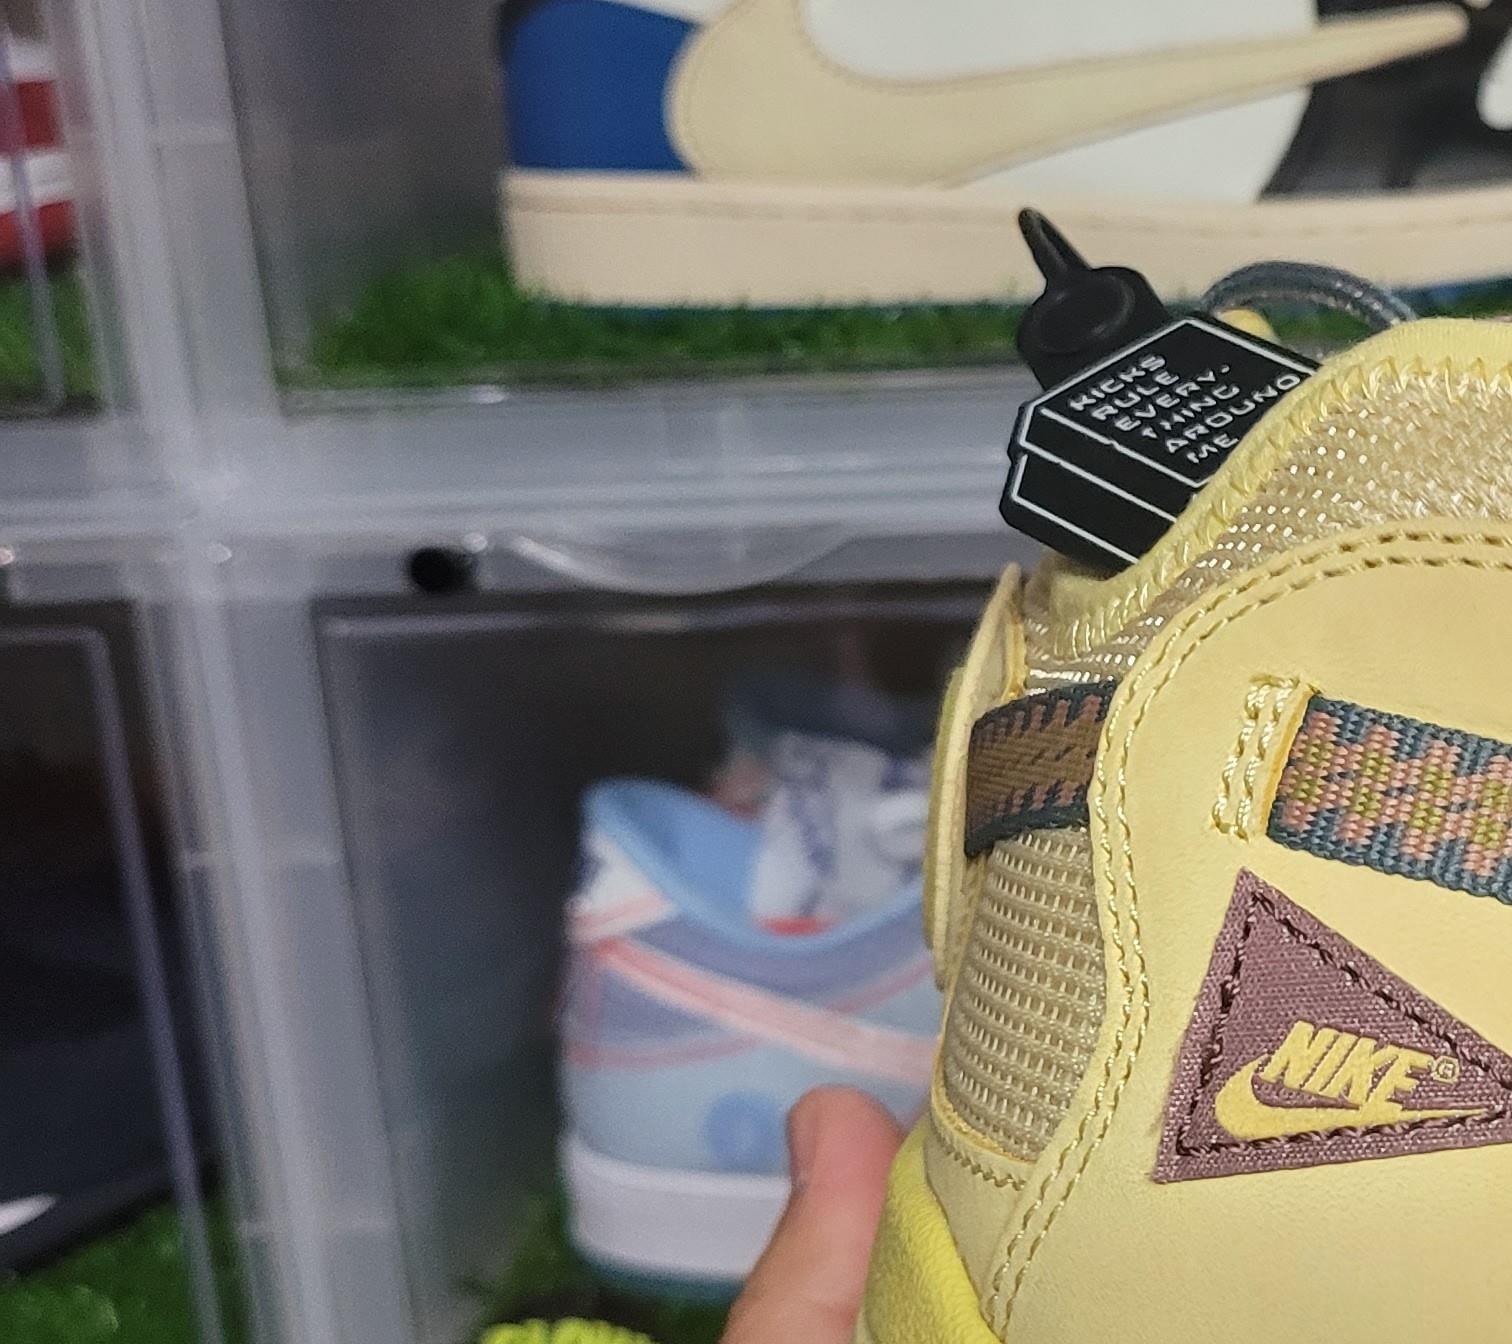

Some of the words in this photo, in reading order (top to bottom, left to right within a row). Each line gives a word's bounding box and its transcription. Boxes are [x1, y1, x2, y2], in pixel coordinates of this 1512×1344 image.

[1069, 354, 1166, 412] KICKS
[1091, 371, 1180, 422] RULE
[1141, 385, 1240, 439] THING
[1165, 373, 1301, 454] AROUND
[1187, 435, 1239, 464] ME
[1259, 1019, 1433, 1112] NIKE
